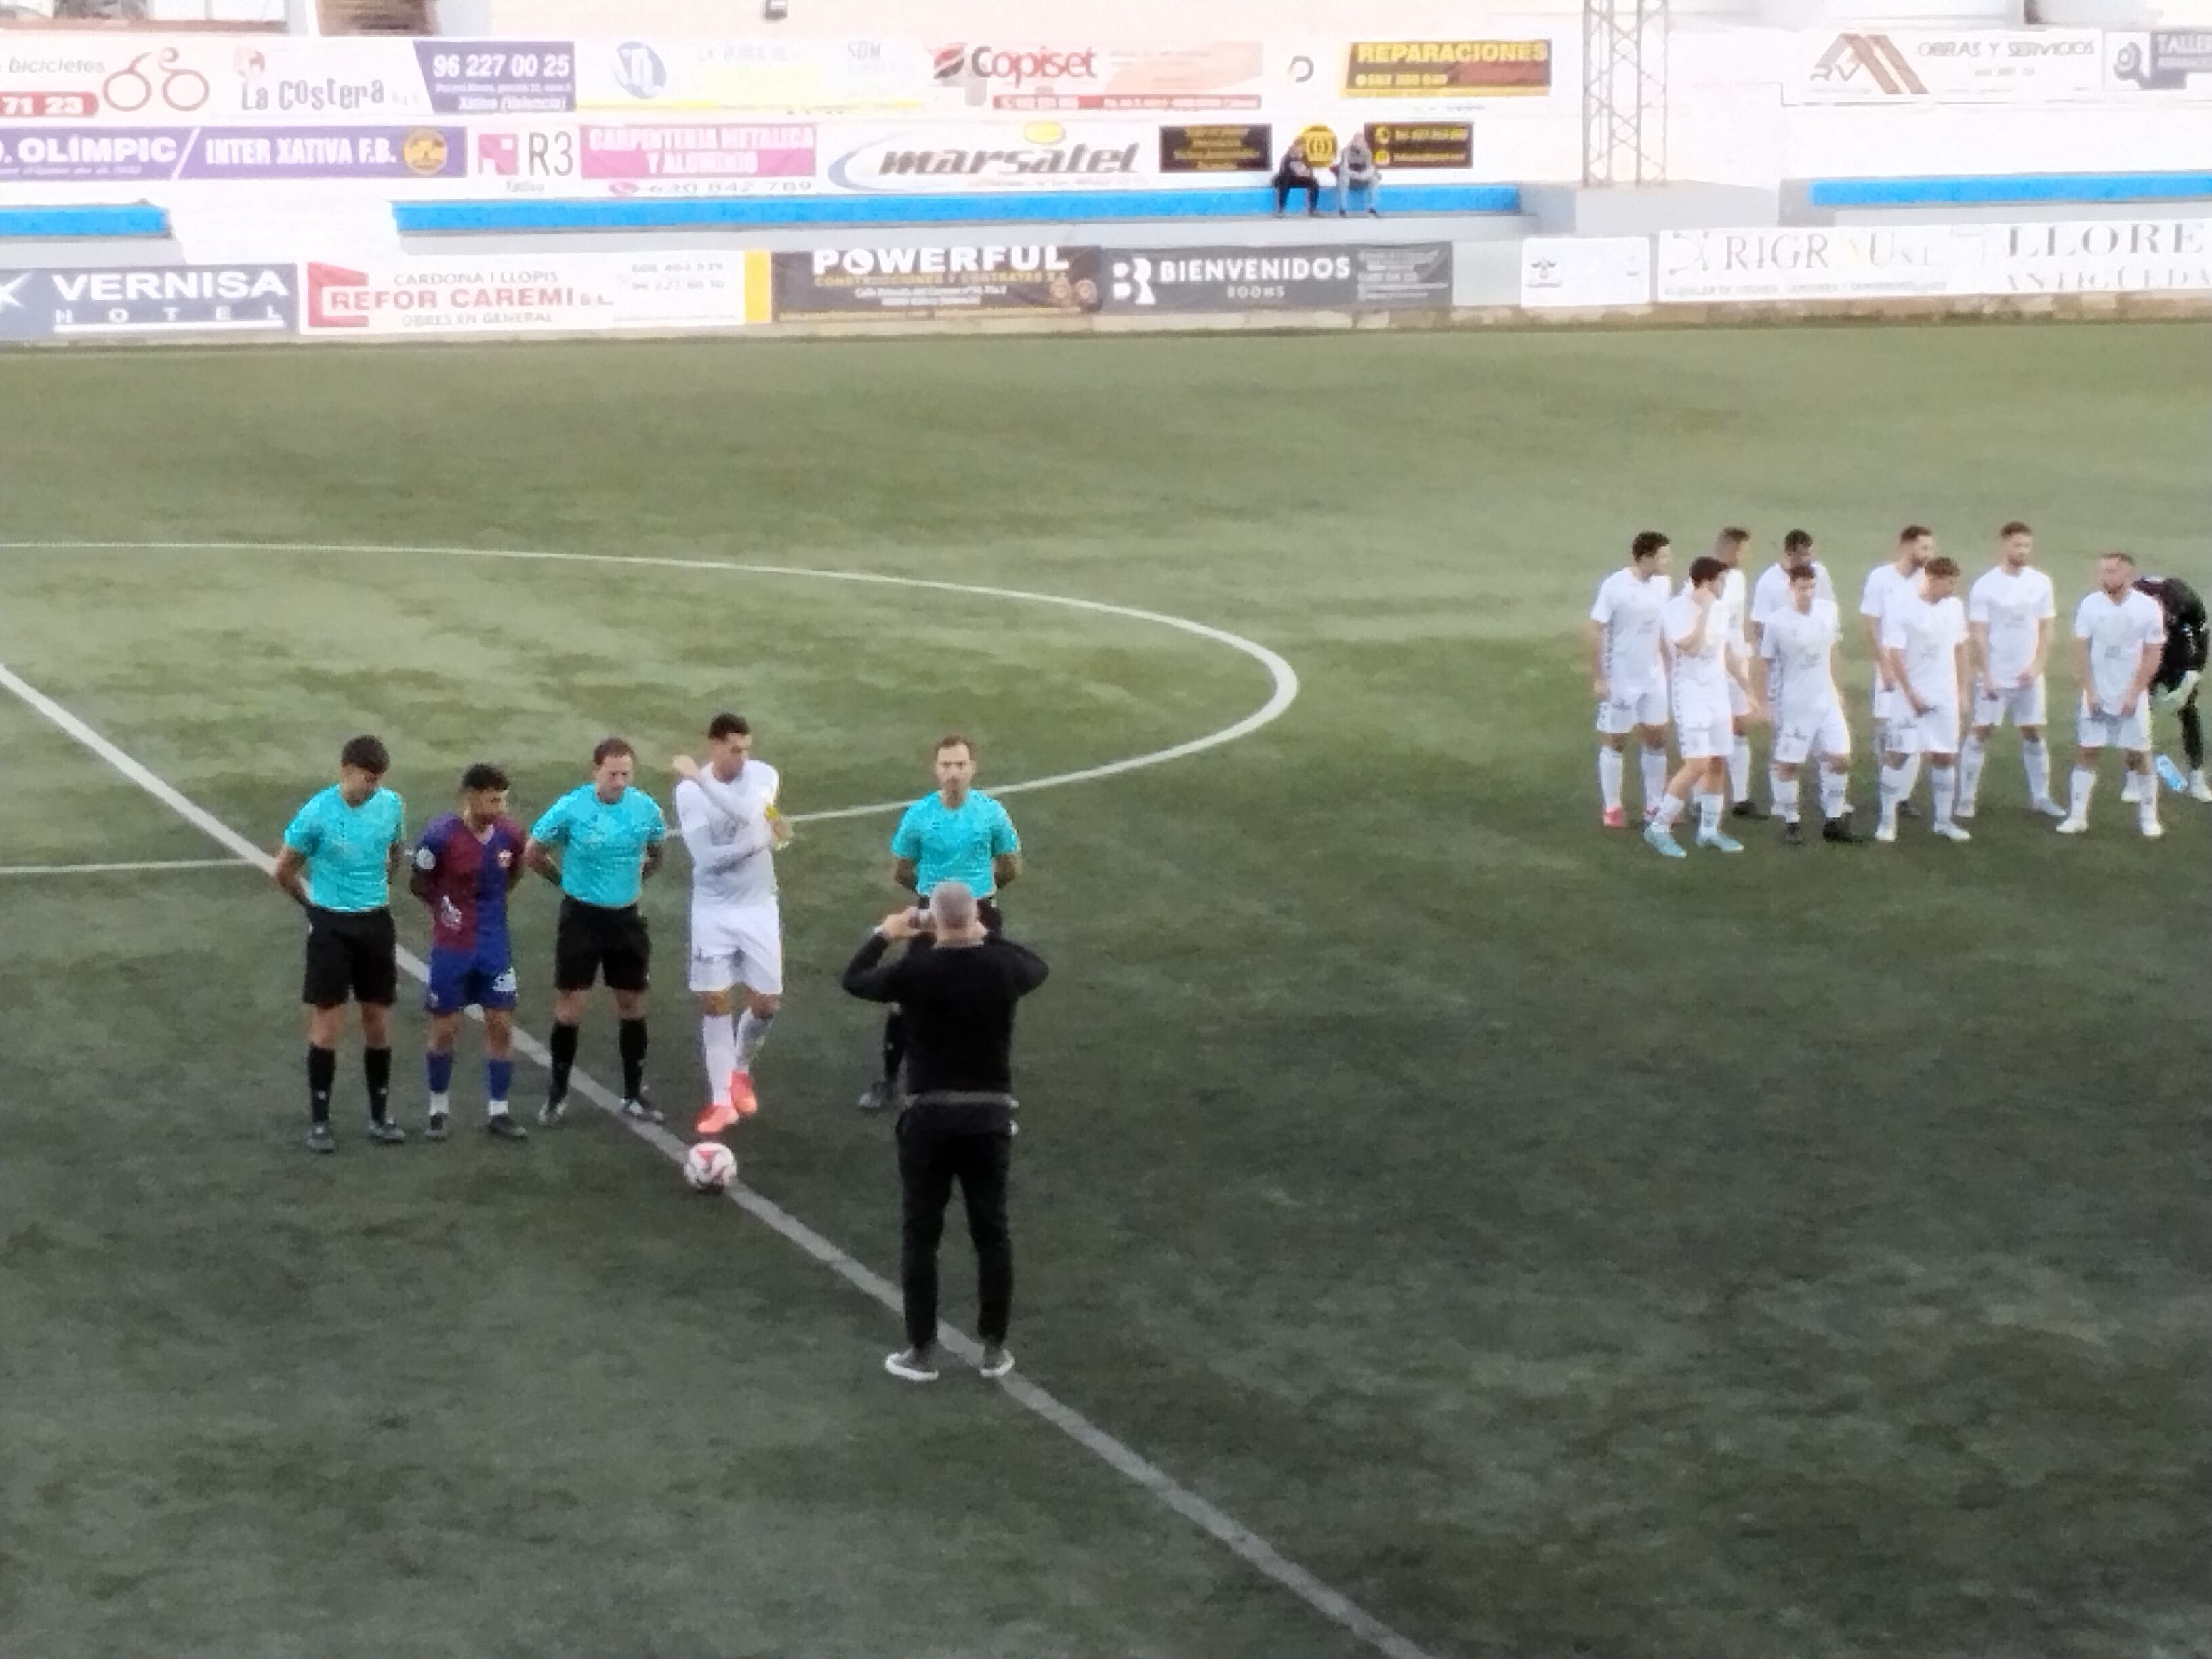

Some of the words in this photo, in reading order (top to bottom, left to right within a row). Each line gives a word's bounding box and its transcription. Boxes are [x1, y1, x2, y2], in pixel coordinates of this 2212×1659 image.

[1357, 43, 1547, 62] REPARACIONES
[1917, 41, 1981, 57] OBRAS
[1988, 41, 2001, 57] Y
[434, 54, 461, 77] 96
[465, 54, 506, 77] 227
[510, 54, 538, 77] 00
[544, 54, 570, 77] 25
[971, 45, 1099, 89] Copiset
[2, 96, 33, 115] 71
[45, 96, 83, 115] 23
[241, 79, 269, 110] La
[278, 77, 384, 110] Costera
[207, 138, 270, 164] INTER
[528, 131, 573, 176] R3
[879, 143, 1140, 175] marsatel
[814, 245, 1069, 274] POWERFUL
[1160, 257, 1351, 283] BIENVENIDOS
[52, 270, 290, 302] VERNISA
[394, 272, 483, 287] CARDONA
[500, 271, 558, 284] LLOPIS
[331, 289, 439, 311] REFOR
[450, 287, 575, 308] CAREMI
[56, 305, 283, 324] HOTEL
